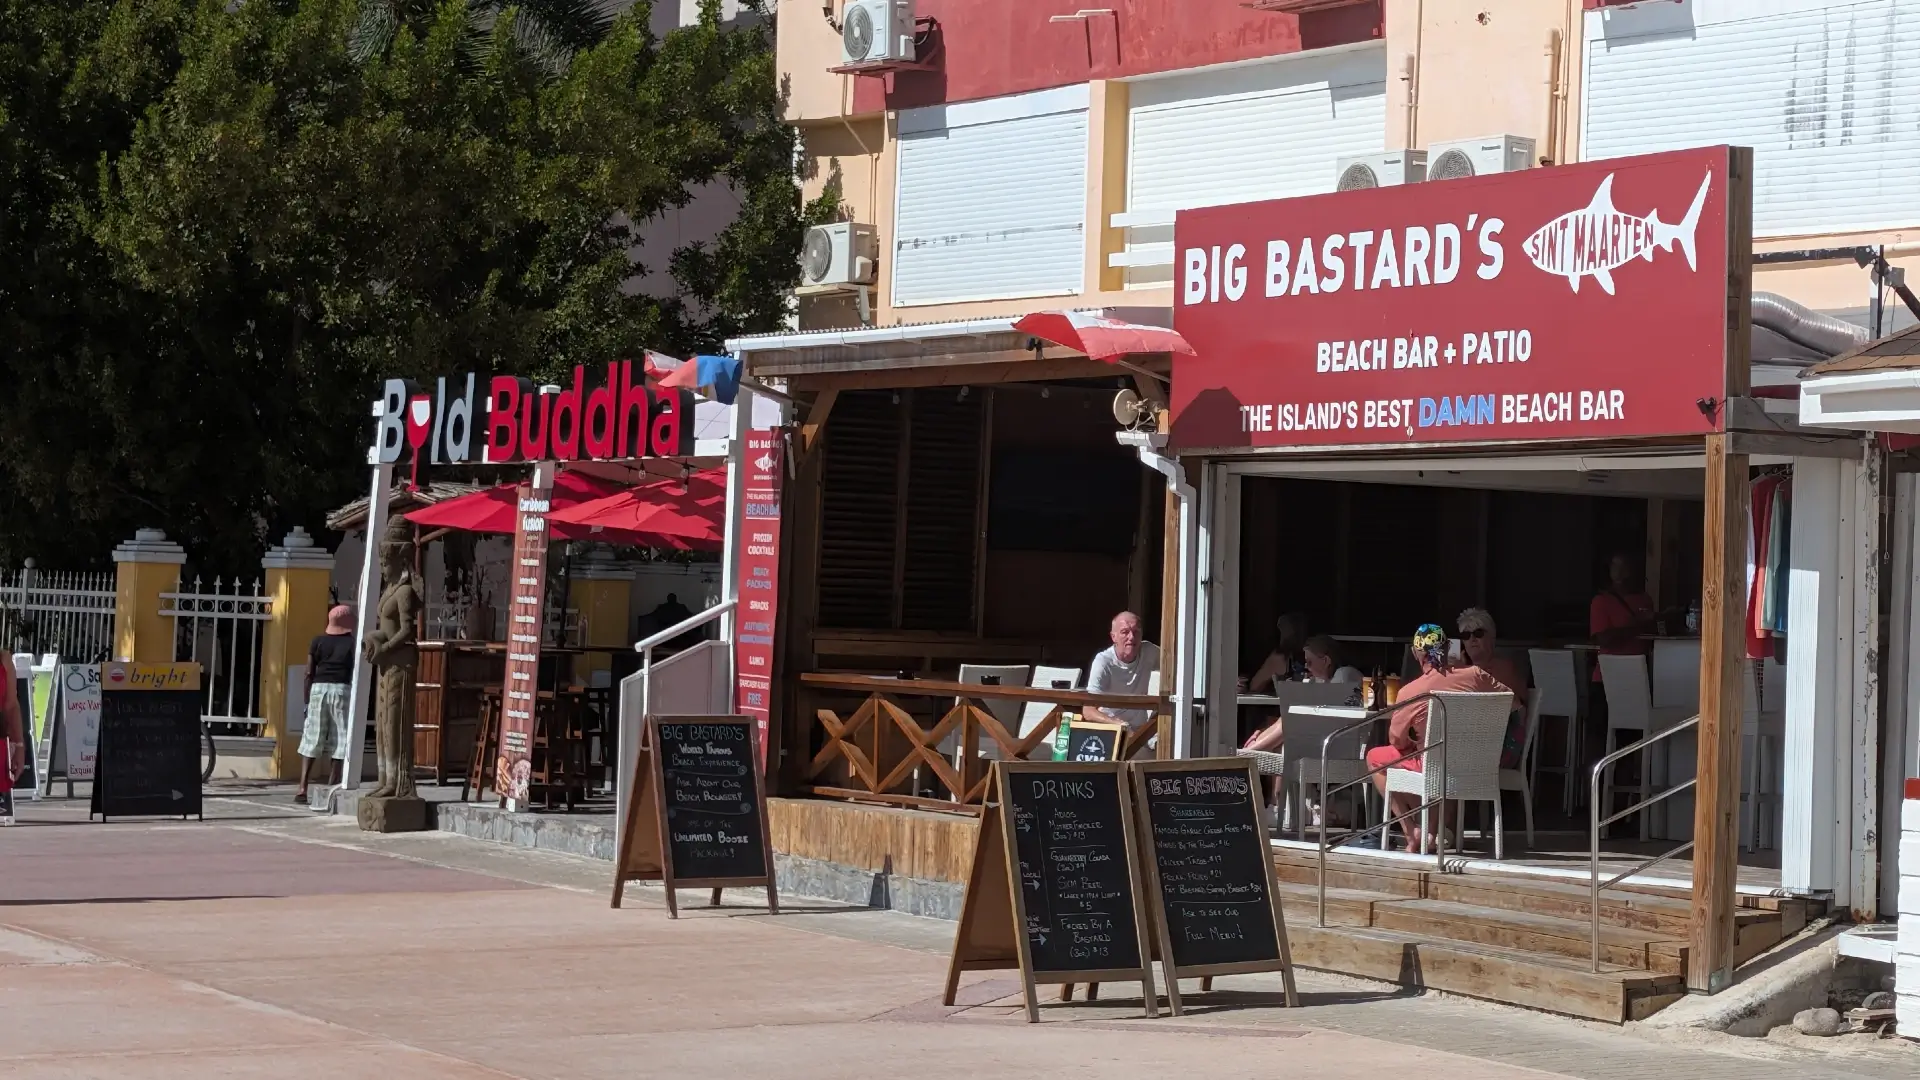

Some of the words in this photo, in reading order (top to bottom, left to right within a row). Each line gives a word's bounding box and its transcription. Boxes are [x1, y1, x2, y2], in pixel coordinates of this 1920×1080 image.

[1531, 217, 1569, 272] SINT
[1572, 213, 1654, 273] MAARTEN
[1184, 243, 1248, 306] BIG
[1265, 213, 1505, 298] BASTARD'S
[1316, 337, 1387, 373] BEACH
[1393, 335, 1439, 369] BAR
[1462, 329, 1532, 364] PATIO
[487, 359, 682, 464] Buddha
[1239, 404, 1273, 433] THE
[1277, 400, 1358, 431] ISLAND'S
[1364, 398, 1414, 428] BEST
[1419, 393, 1496, 428] DAMN
[1501, 391, 1573, 424] BEACH
[1579, 389, 1625, 421] BAR
[746, 503, 769, 516] BEACH
[747, 545, 775, 556] COCKTAILS
[130, 667, 188, 688] bright
[662, 725, 684, 740] BIG
[690, 725, 745, 741] BASTARD'S
[1032, 780, 1095, 799] DRINKS
[1150, 778, 1182, 796] BIG
[674, 832, 713, 843] UNLIMITED
[718, 831, 749, 843] BOOZE
